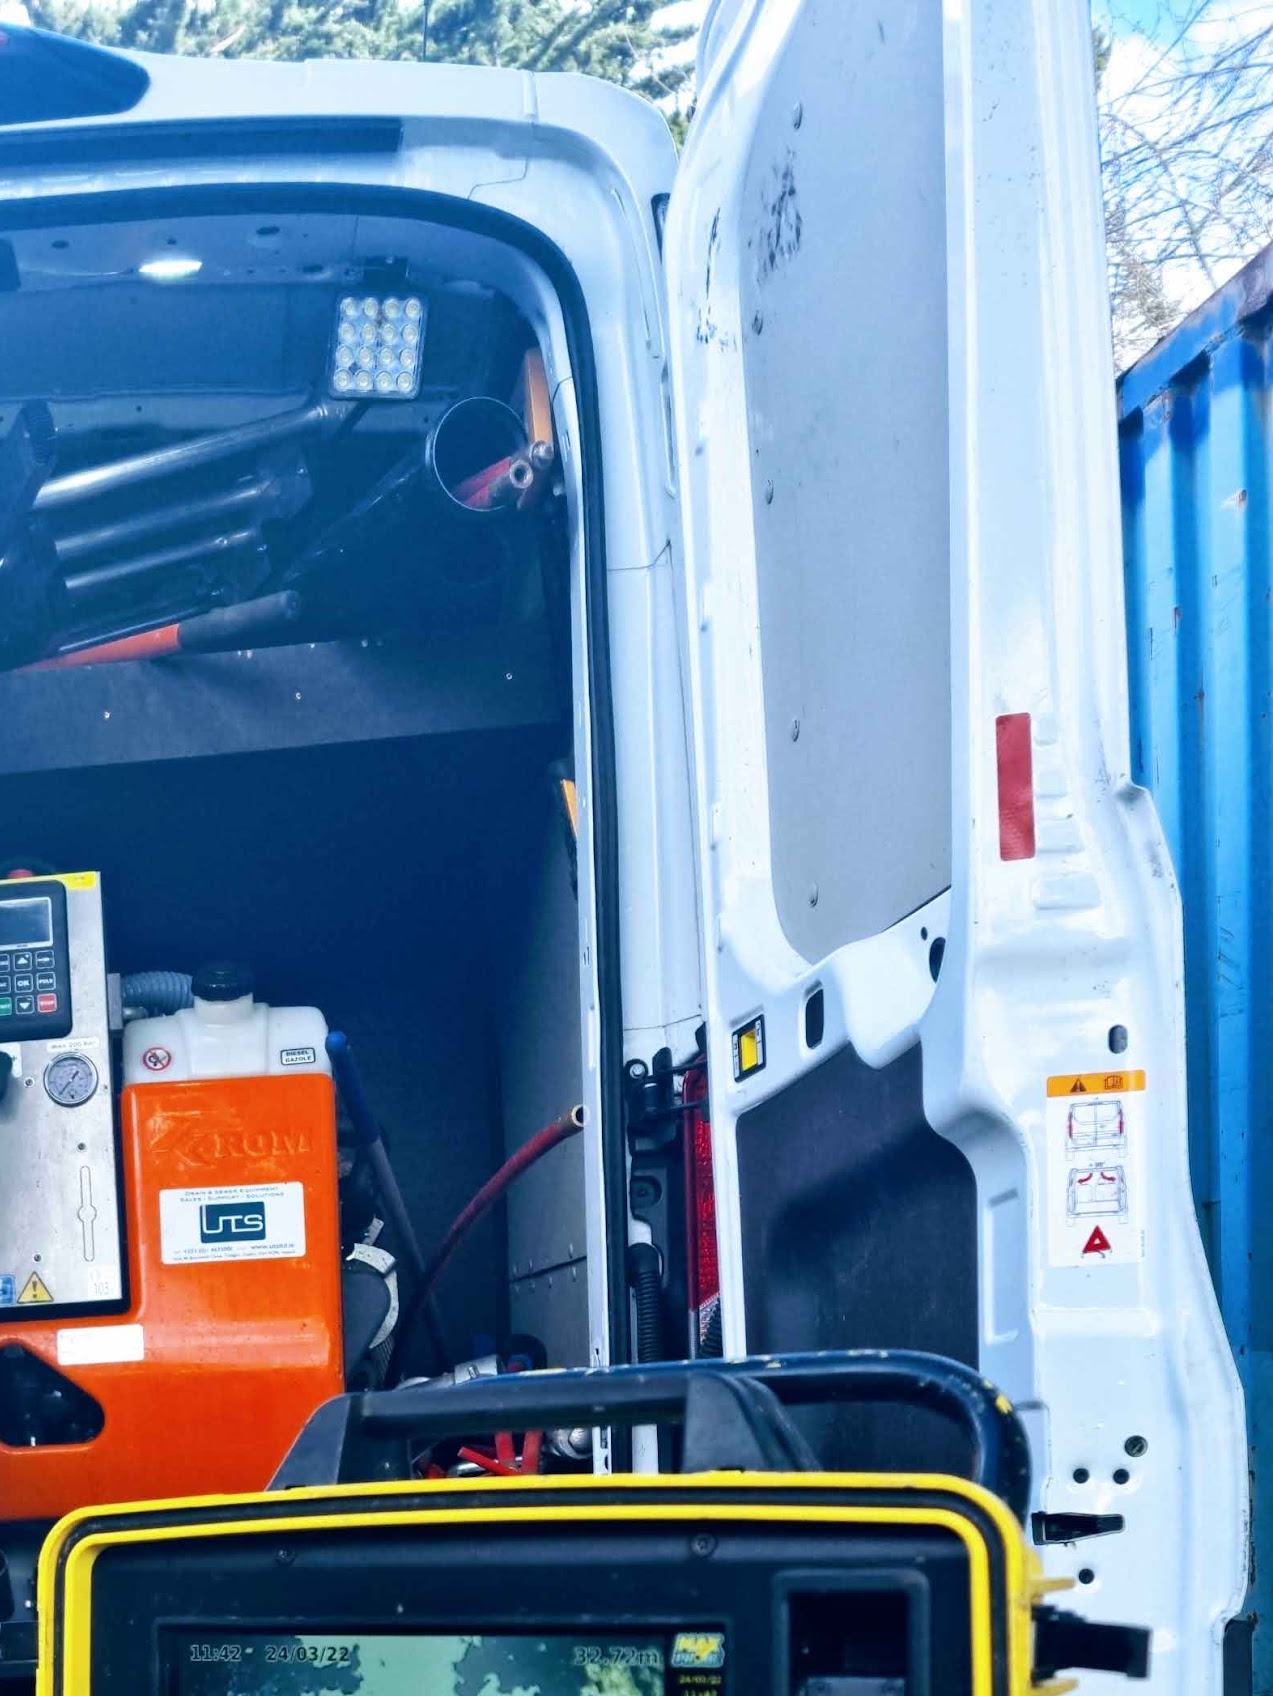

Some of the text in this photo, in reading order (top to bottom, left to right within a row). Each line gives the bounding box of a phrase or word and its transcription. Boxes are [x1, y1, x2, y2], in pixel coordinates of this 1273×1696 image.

[202, 1204, 264, 1234] UTS
[190, 1644, 350, 1664] 11:42 24/03/22
[574, 1646, 660, 1665] 32.72m
